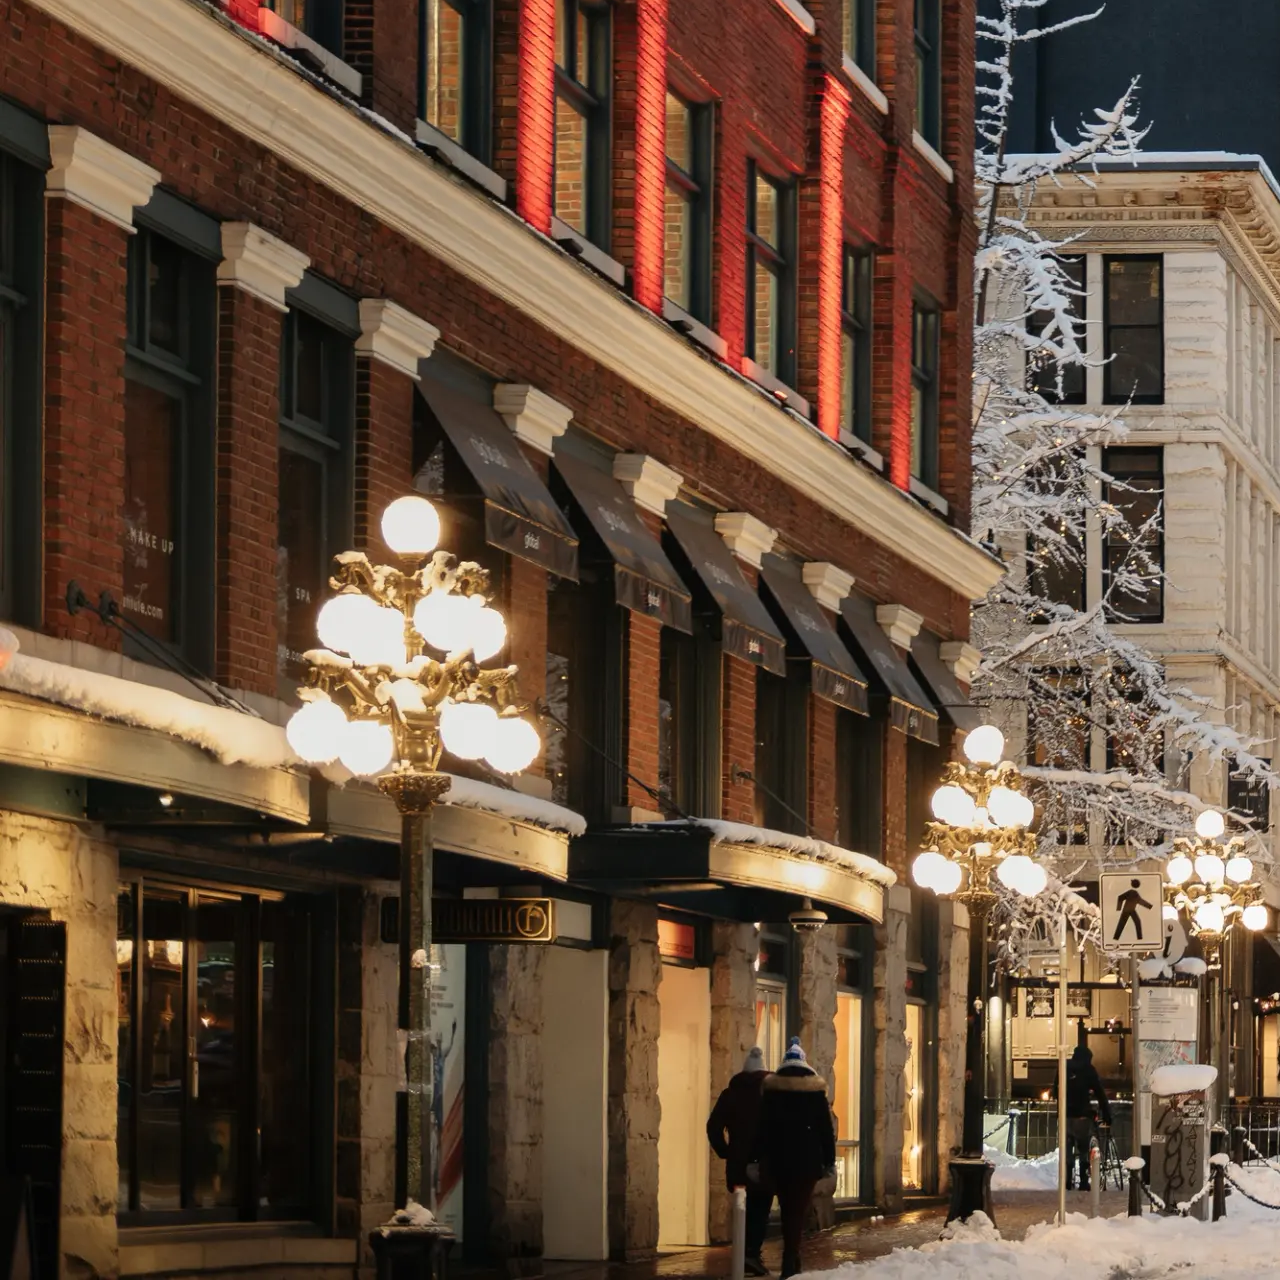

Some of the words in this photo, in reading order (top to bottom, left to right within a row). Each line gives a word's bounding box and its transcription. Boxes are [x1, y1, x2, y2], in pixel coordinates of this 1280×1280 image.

[130, 527, 157, 550] MAKE
[161, 539, 174, 555] UP
[296, 588, 311, 604] SPA
